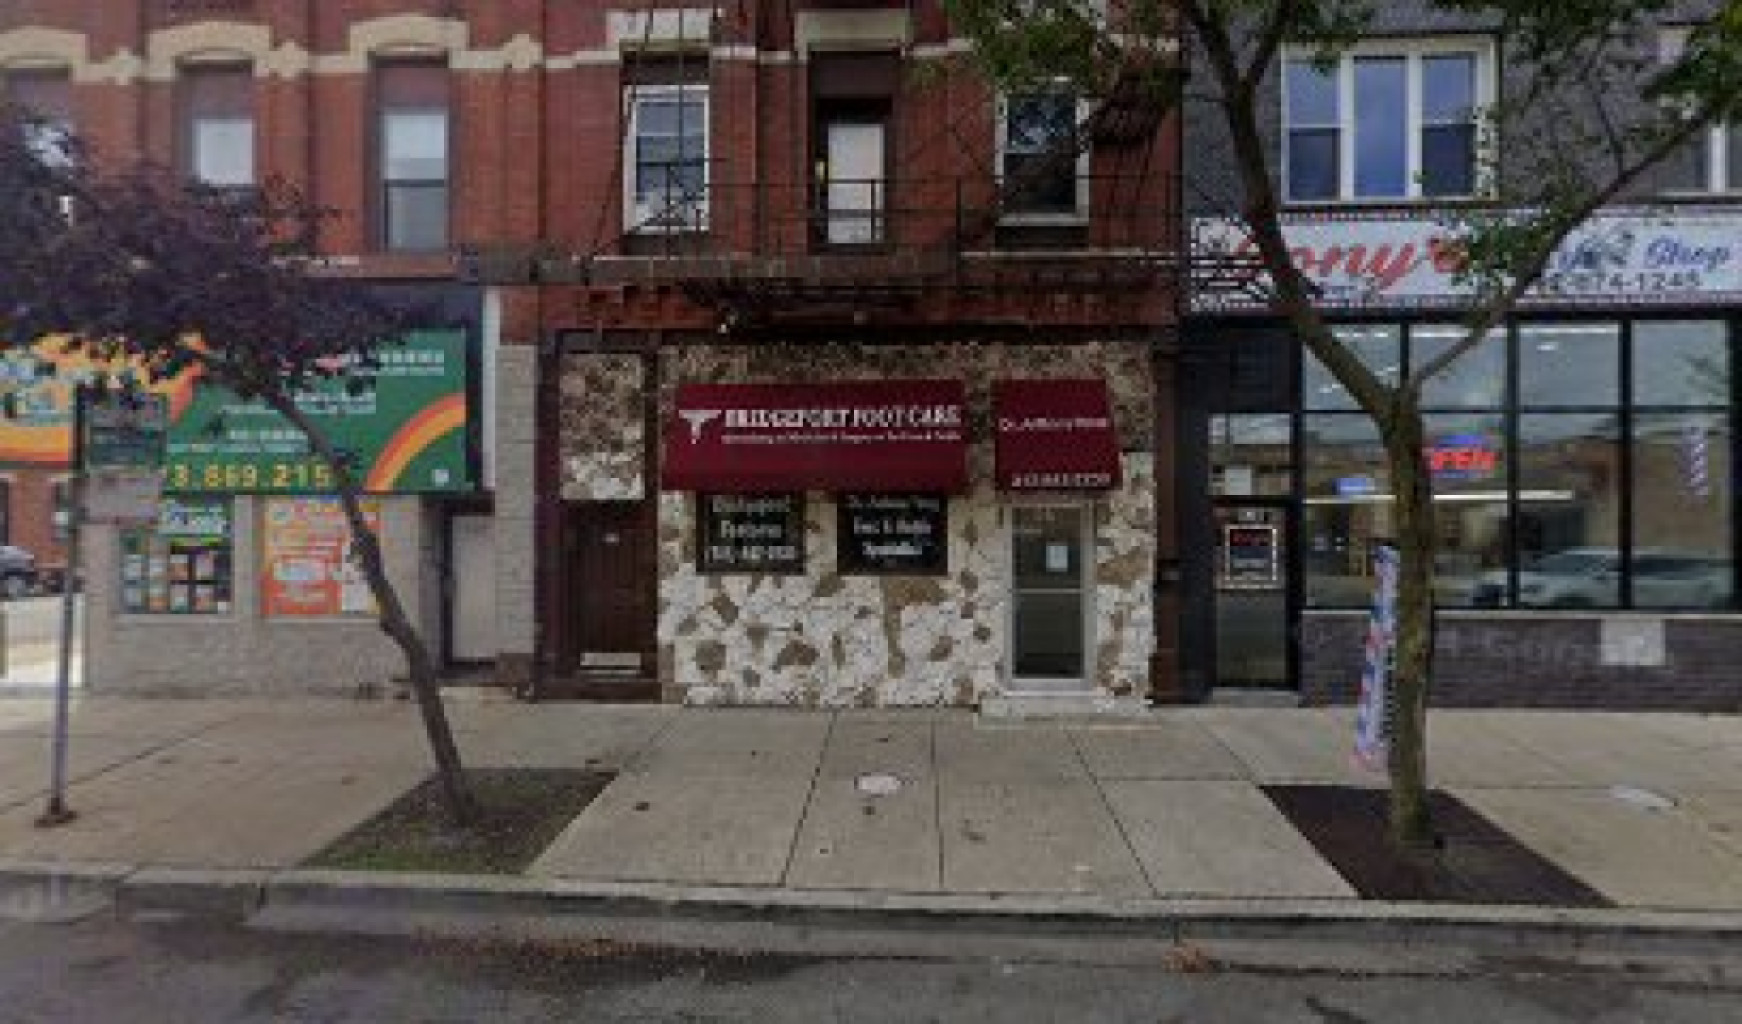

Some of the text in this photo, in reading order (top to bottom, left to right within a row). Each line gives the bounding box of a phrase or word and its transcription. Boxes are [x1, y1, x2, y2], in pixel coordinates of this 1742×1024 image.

[724, 404, 961, 428] BRIDGEPORT FOOT CARE
